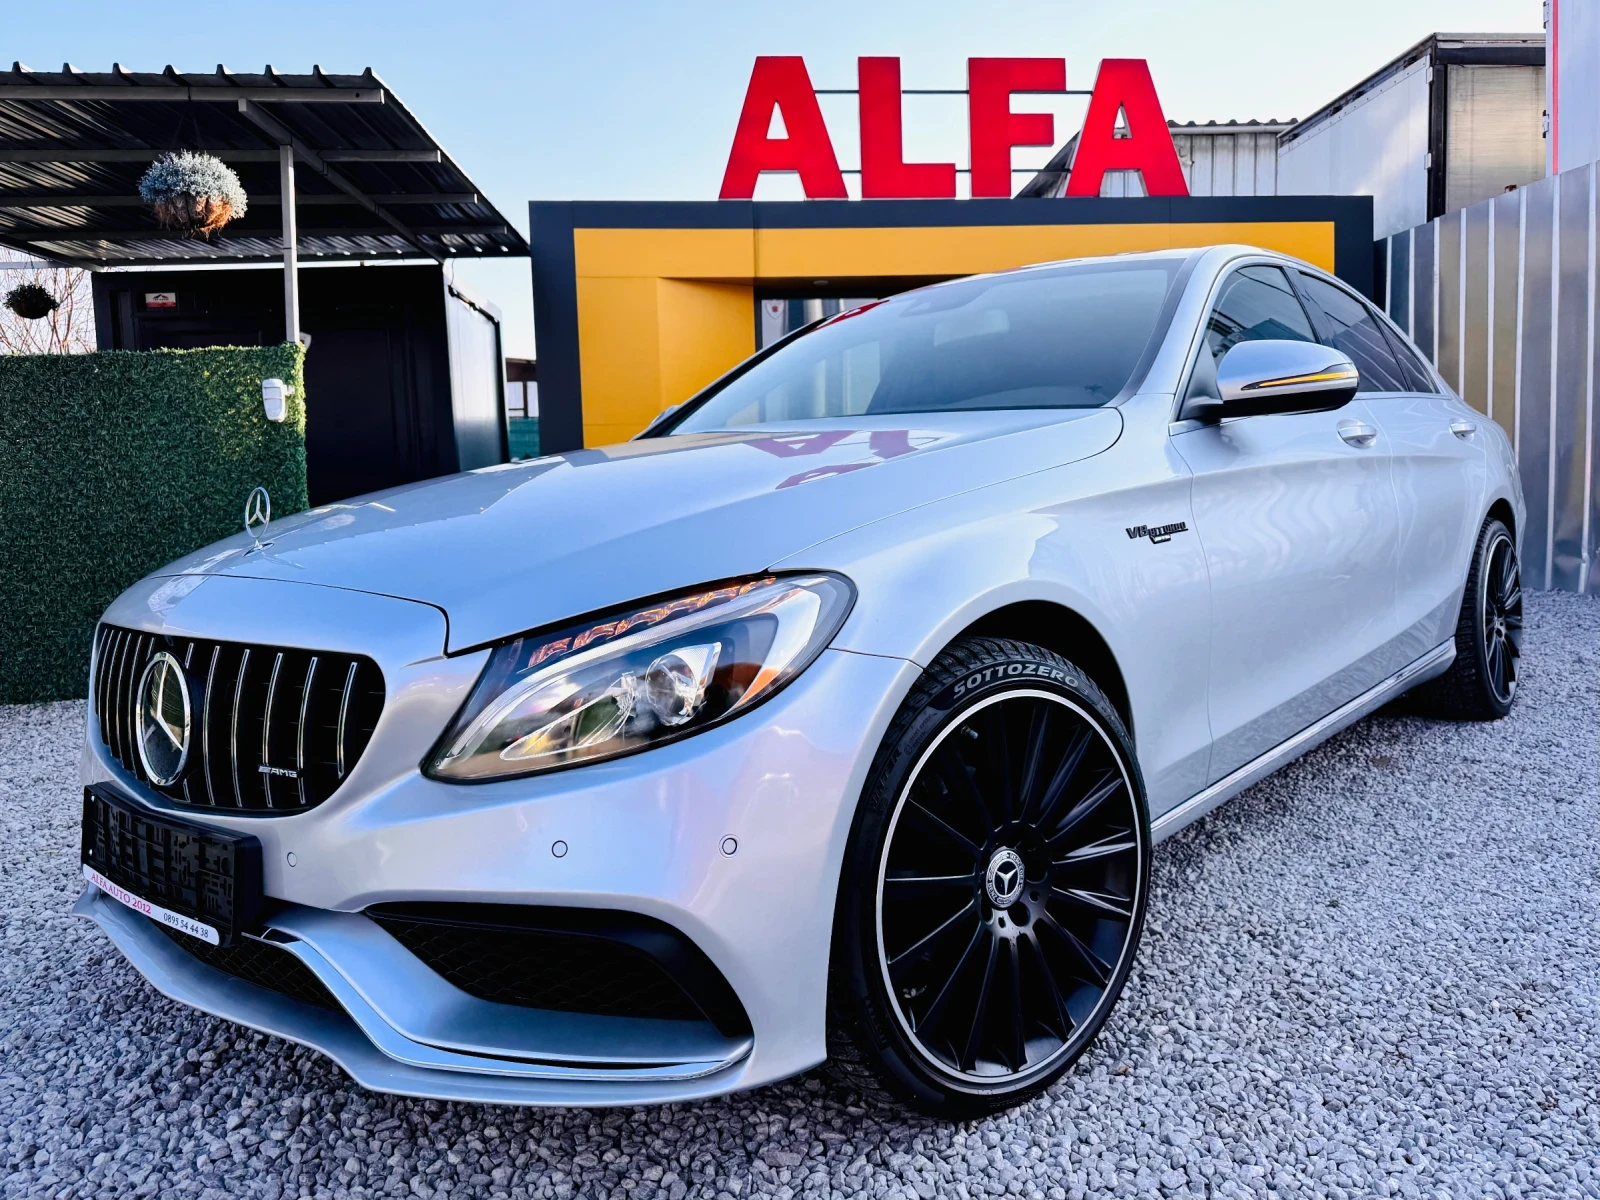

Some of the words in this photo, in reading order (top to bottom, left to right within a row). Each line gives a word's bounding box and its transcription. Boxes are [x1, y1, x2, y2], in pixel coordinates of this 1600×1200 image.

[718, 56, 1190, 198] ALFA
[953, 663, 1079, 700] SOTTOZERO
[270, 767, 298, 778] AMG
[91, 873, 107, 890] ALFA
[108, 885, 131, 903] AUTO
[132, 898, 151, 914] 2012
[163, 912, 179, 926] 0895
[180, 919, 189, 930] 54
[189, 924, 199, 935] 44
[199, 927, 209, 939] 38
